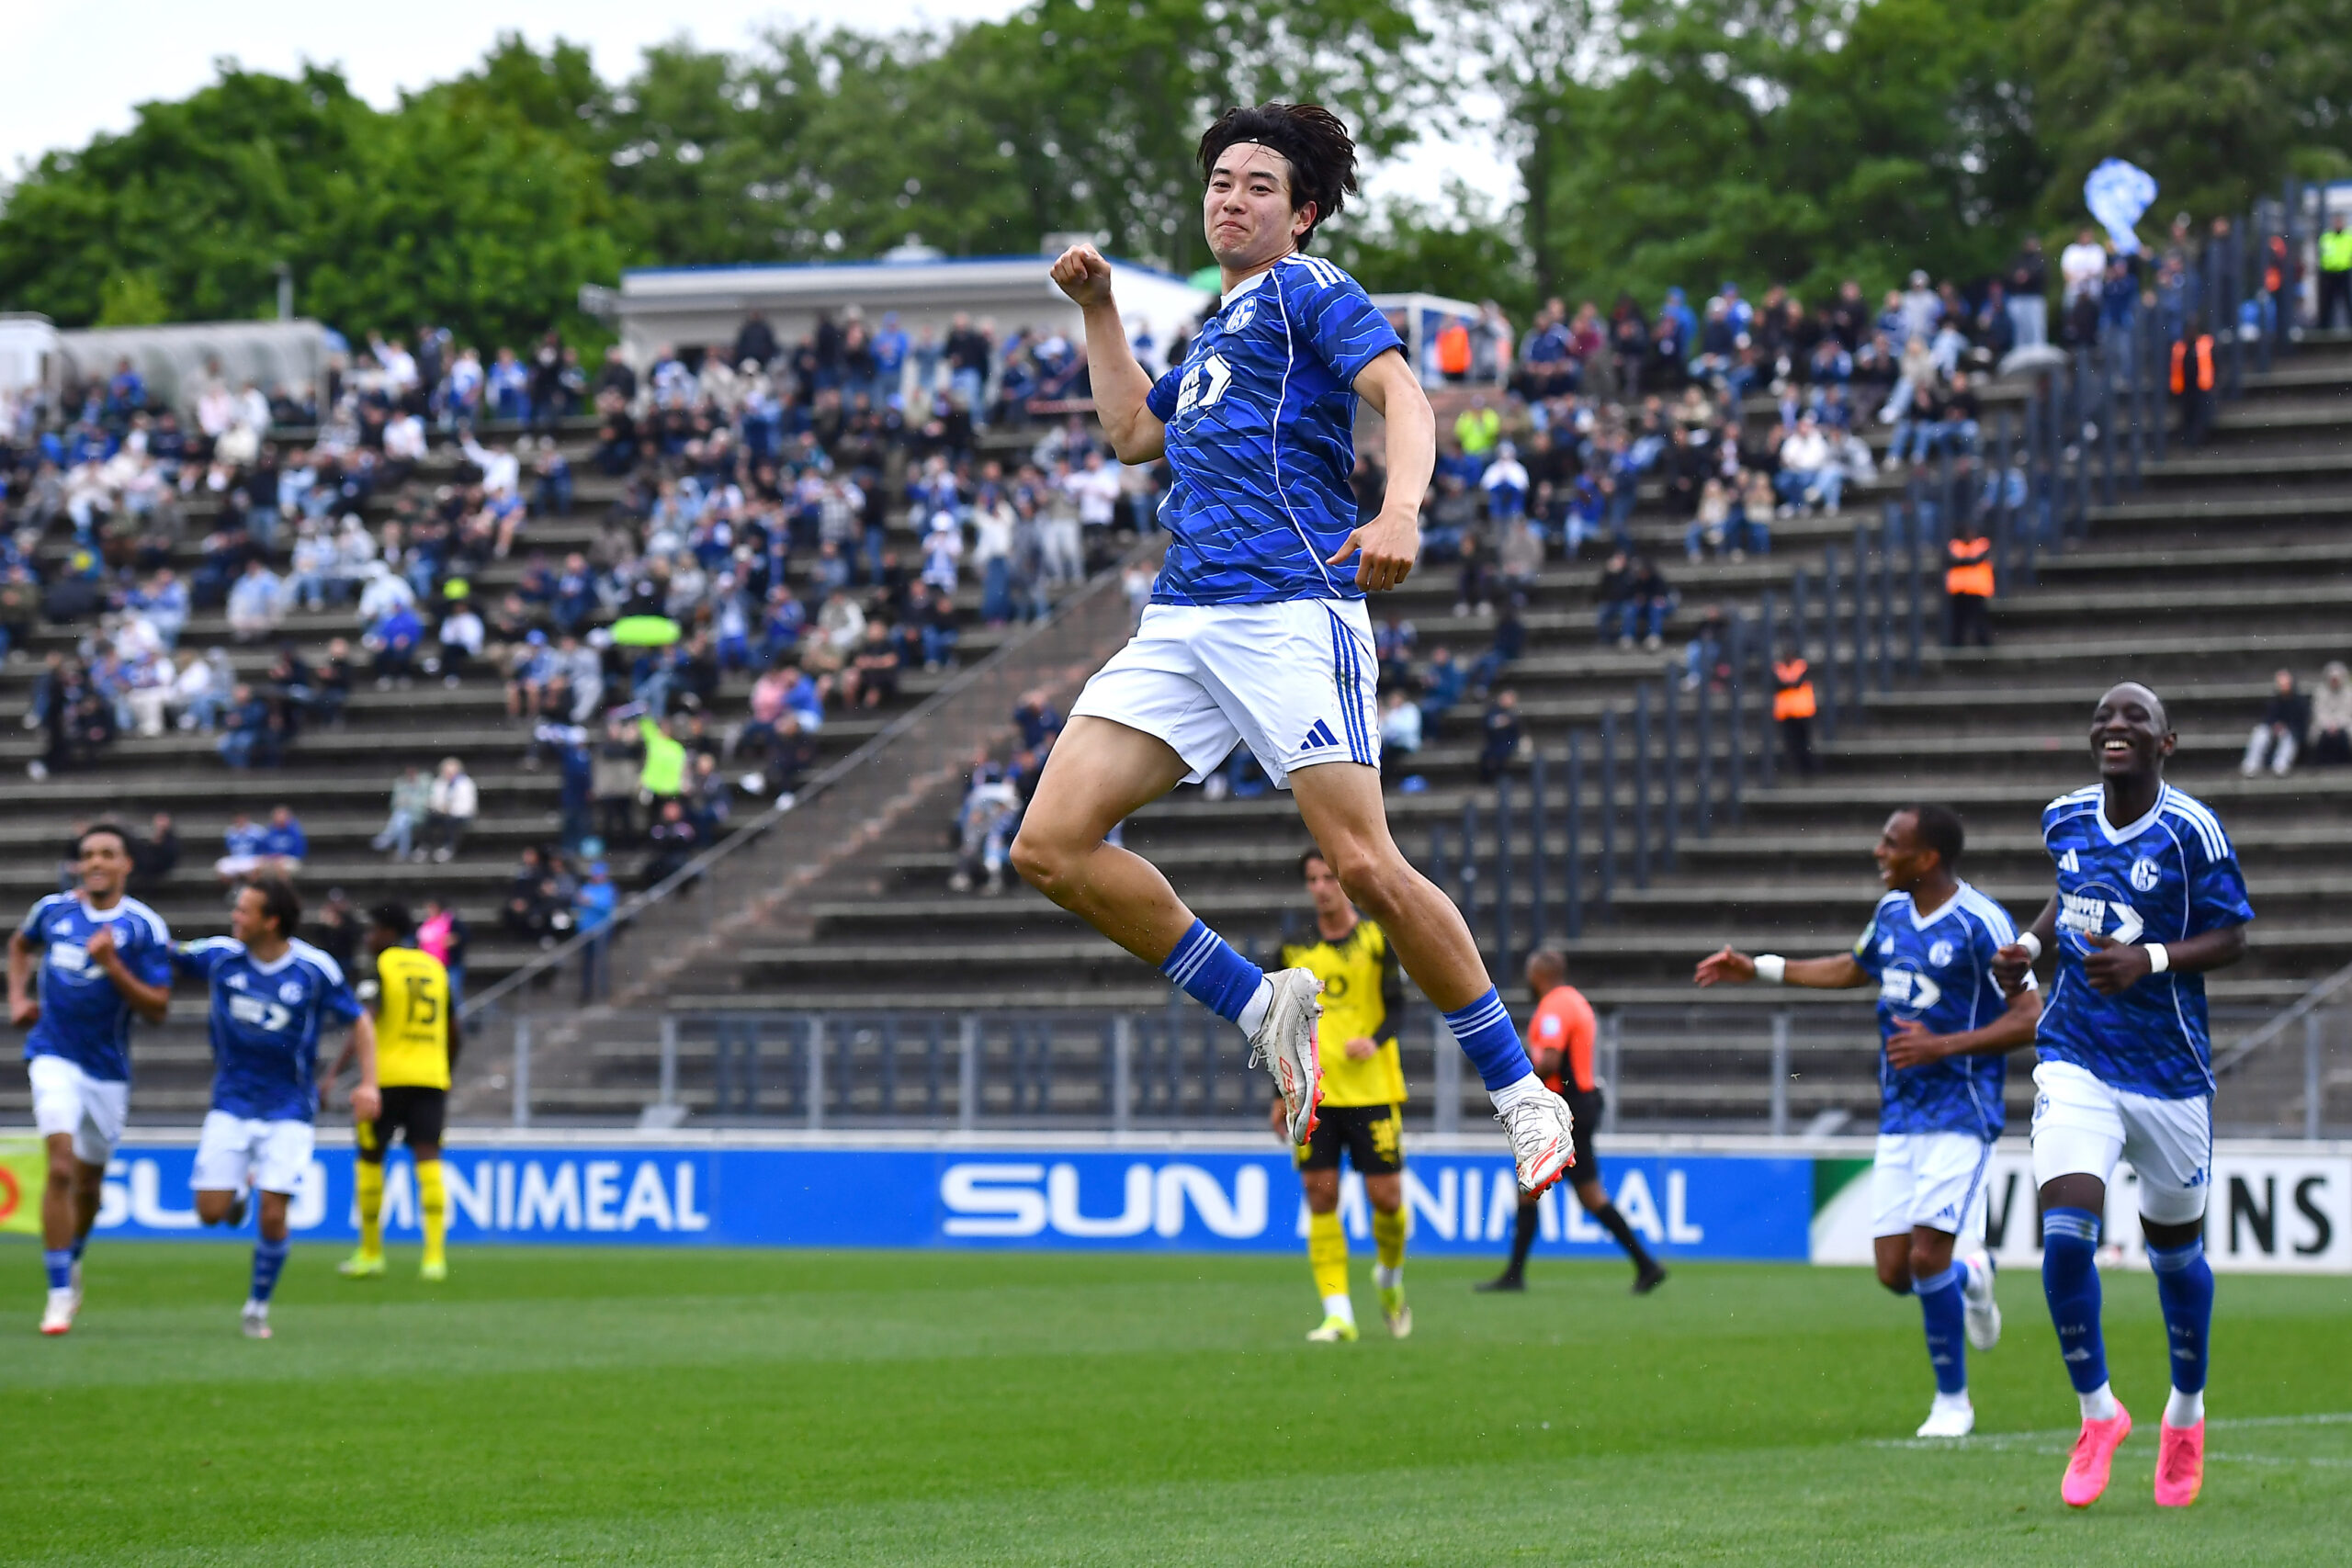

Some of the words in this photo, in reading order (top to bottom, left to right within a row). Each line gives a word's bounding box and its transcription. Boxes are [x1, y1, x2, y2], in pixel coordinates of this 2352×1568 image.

[406, 977, 435, 1025] 15
[348, 1161, 708, 1231] MNIMEAL
[940, 1162, 1269, 1239] SUN
